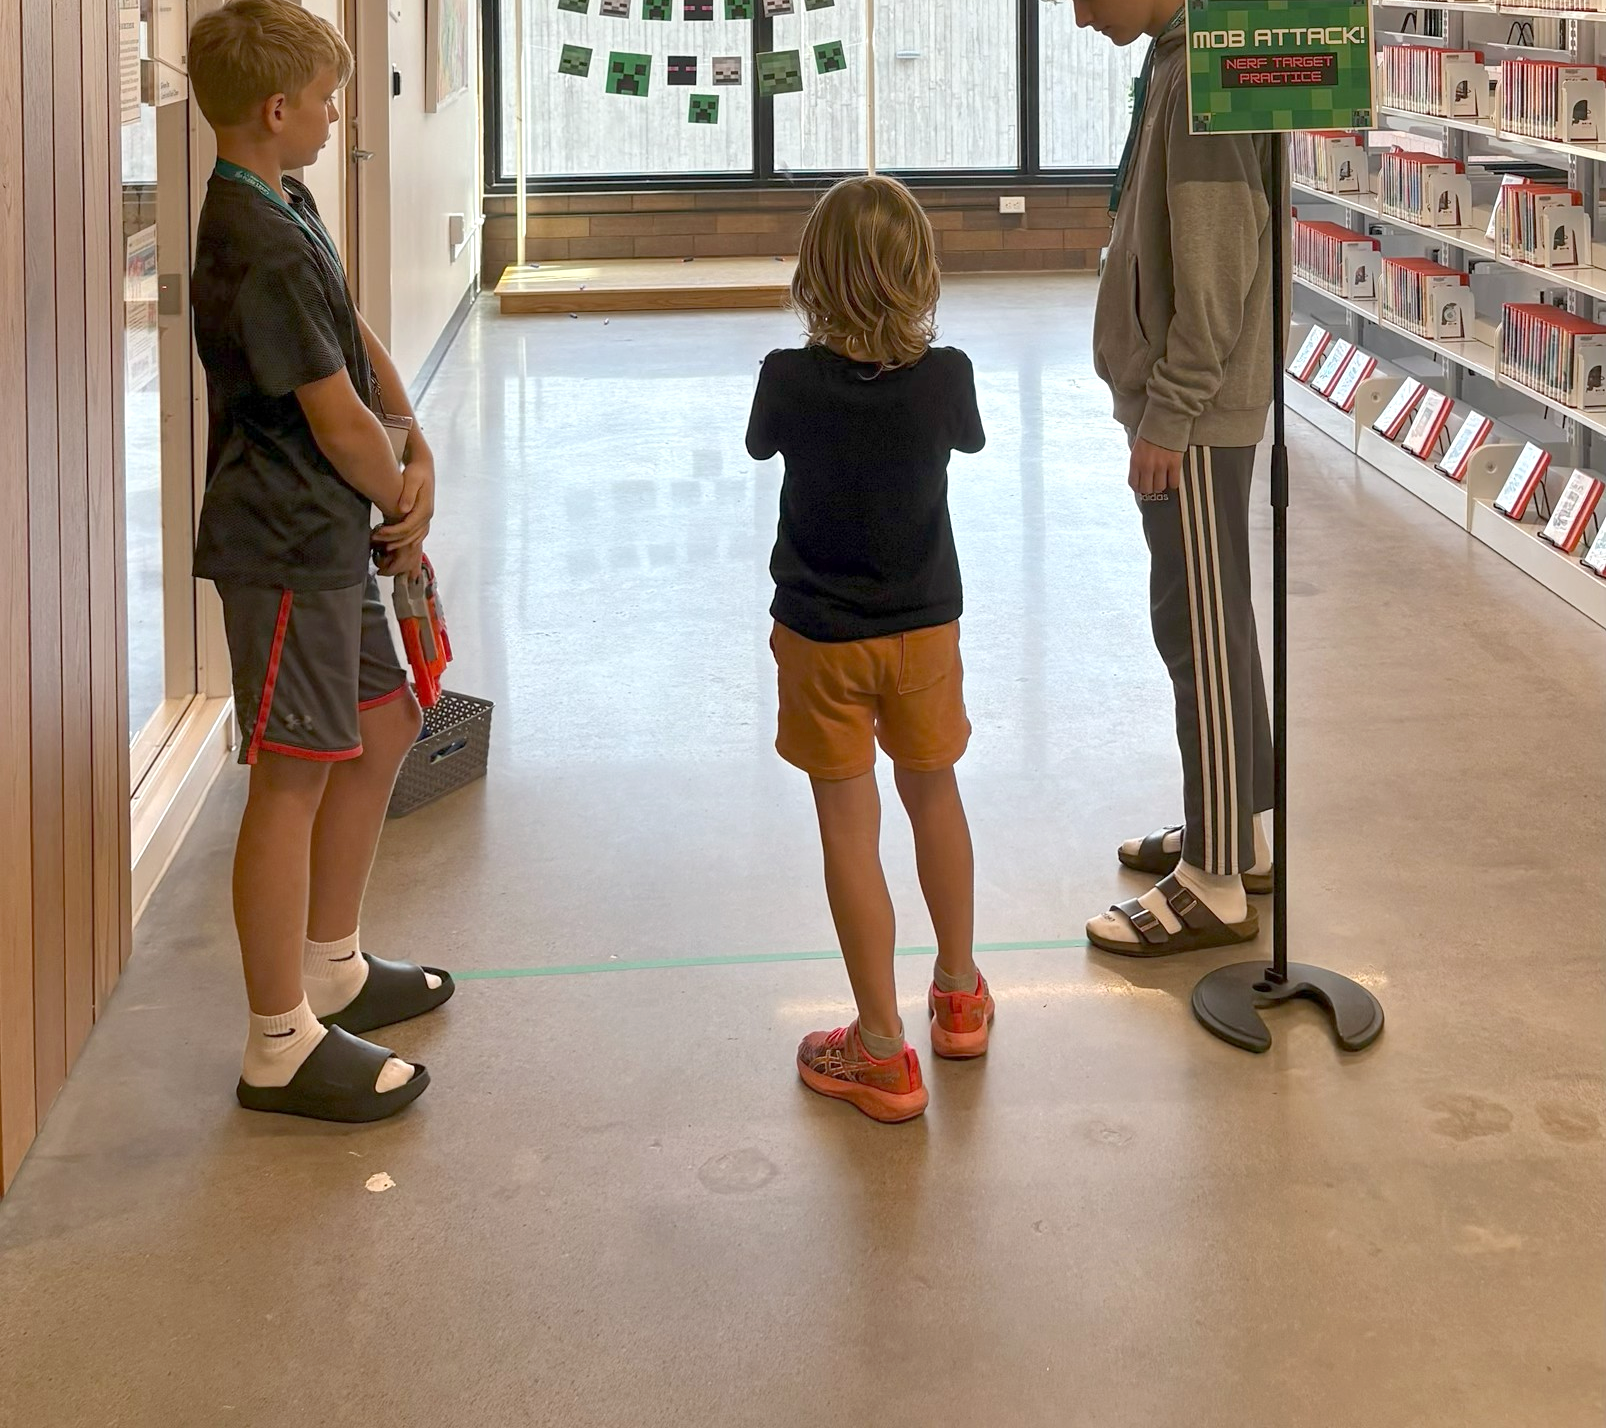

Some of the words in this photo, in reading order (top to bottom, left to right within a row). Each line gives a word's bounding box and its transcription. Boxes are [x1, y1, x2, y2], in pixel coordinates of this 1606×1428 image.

[1192, 30, 1246, 49] MOB
[1254, 26, 1366, 47] ATTACK!
[1226, 57, 1268, 70] NERF
[1272, 55, 1334, 68] TARGET
[1239, 71, 1322, 84] PRACTICE
